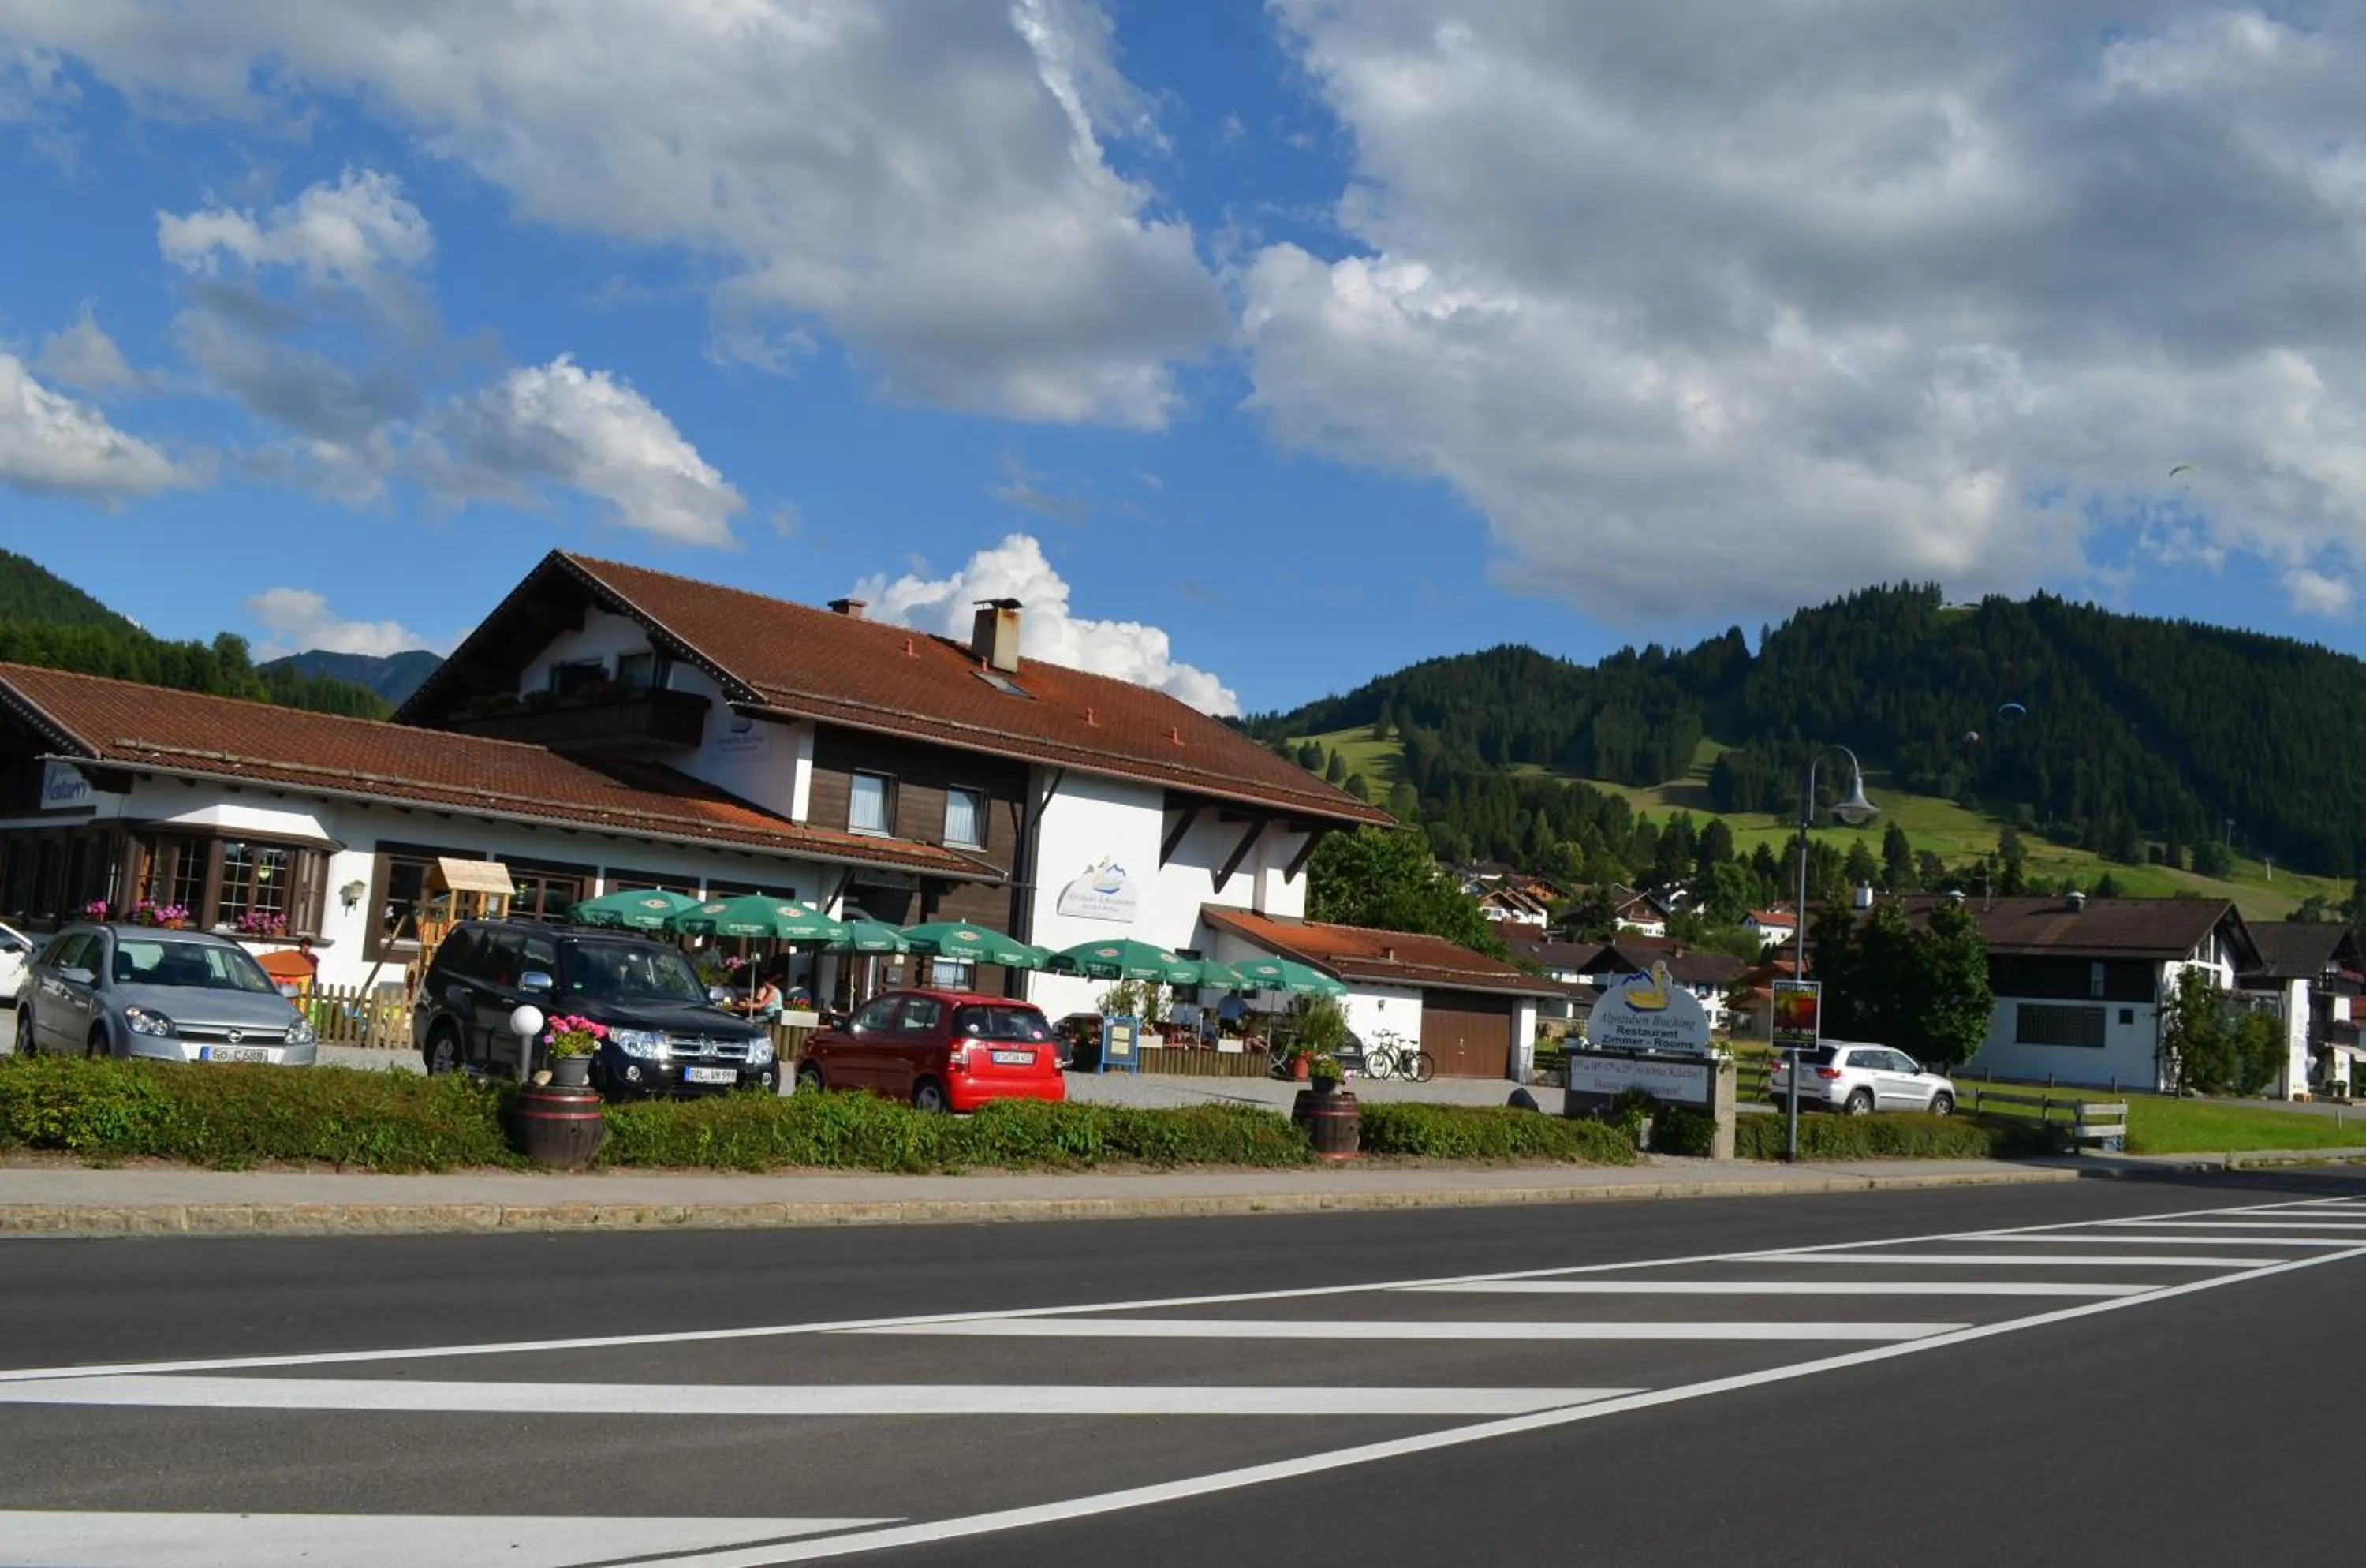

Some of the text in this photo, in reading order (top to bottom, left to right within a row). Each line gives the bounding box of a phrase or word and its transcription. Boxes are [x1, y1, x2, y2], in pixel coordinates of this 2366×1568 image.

[1616, 1025, 1679, 1039] Restaurant
[1601, 1034, 1644, 1045] Zimmer
[1653, 1037, 1696, 1049] Rooms
